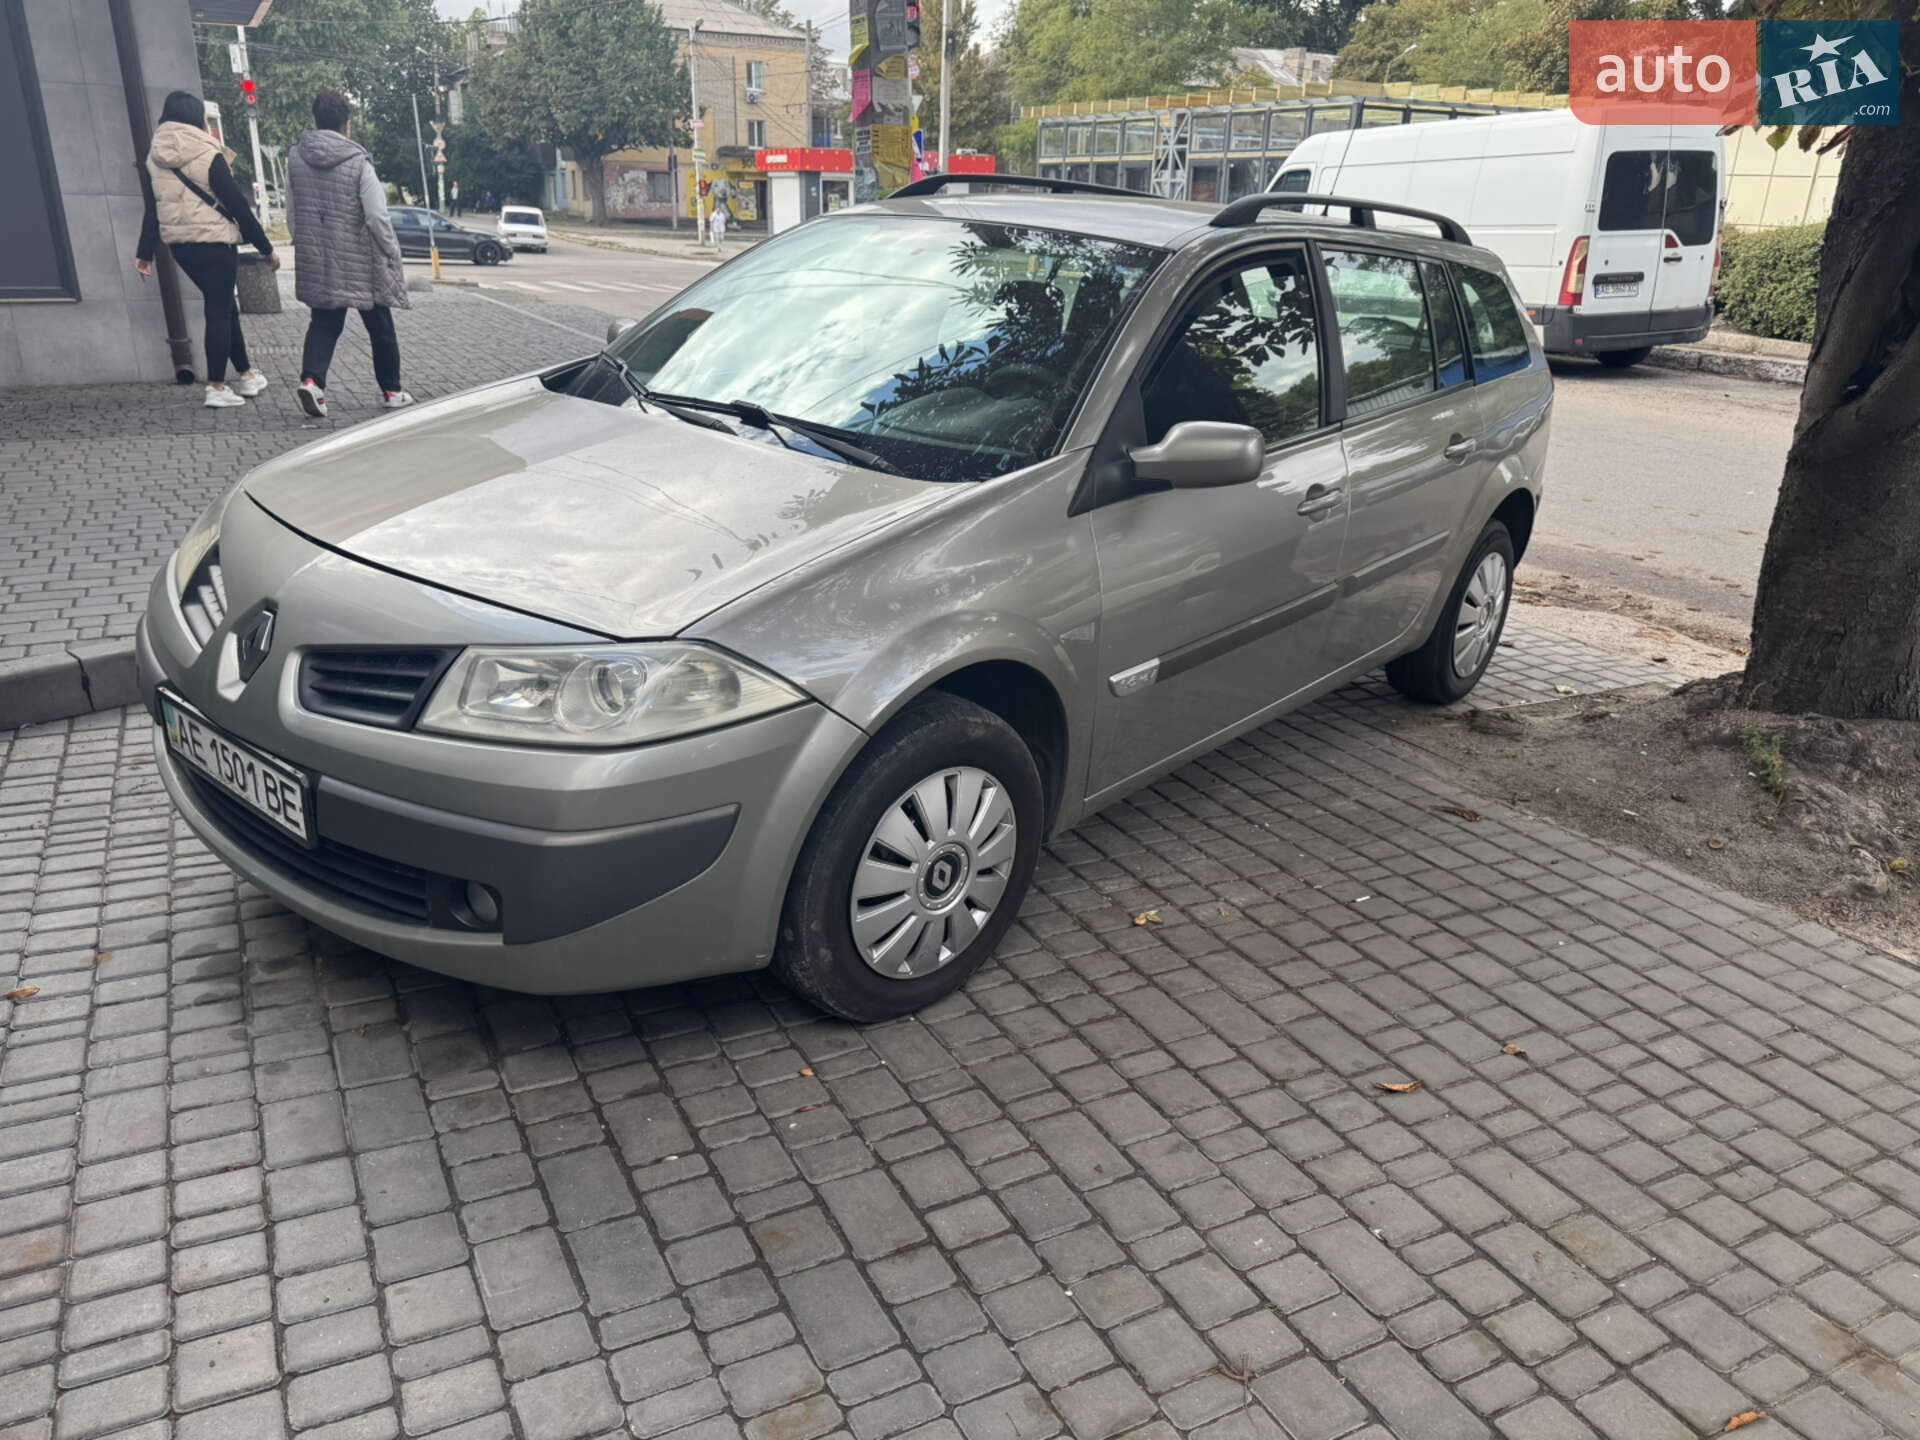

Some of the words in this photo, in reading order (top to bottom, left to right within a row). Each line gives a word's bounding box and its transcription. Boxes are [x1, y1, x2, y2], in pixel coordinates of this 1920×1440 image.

[178, 715, 207, 766] AE
[210, 738, 260, 803] 1501
[263, 769, 300, 828] BE
